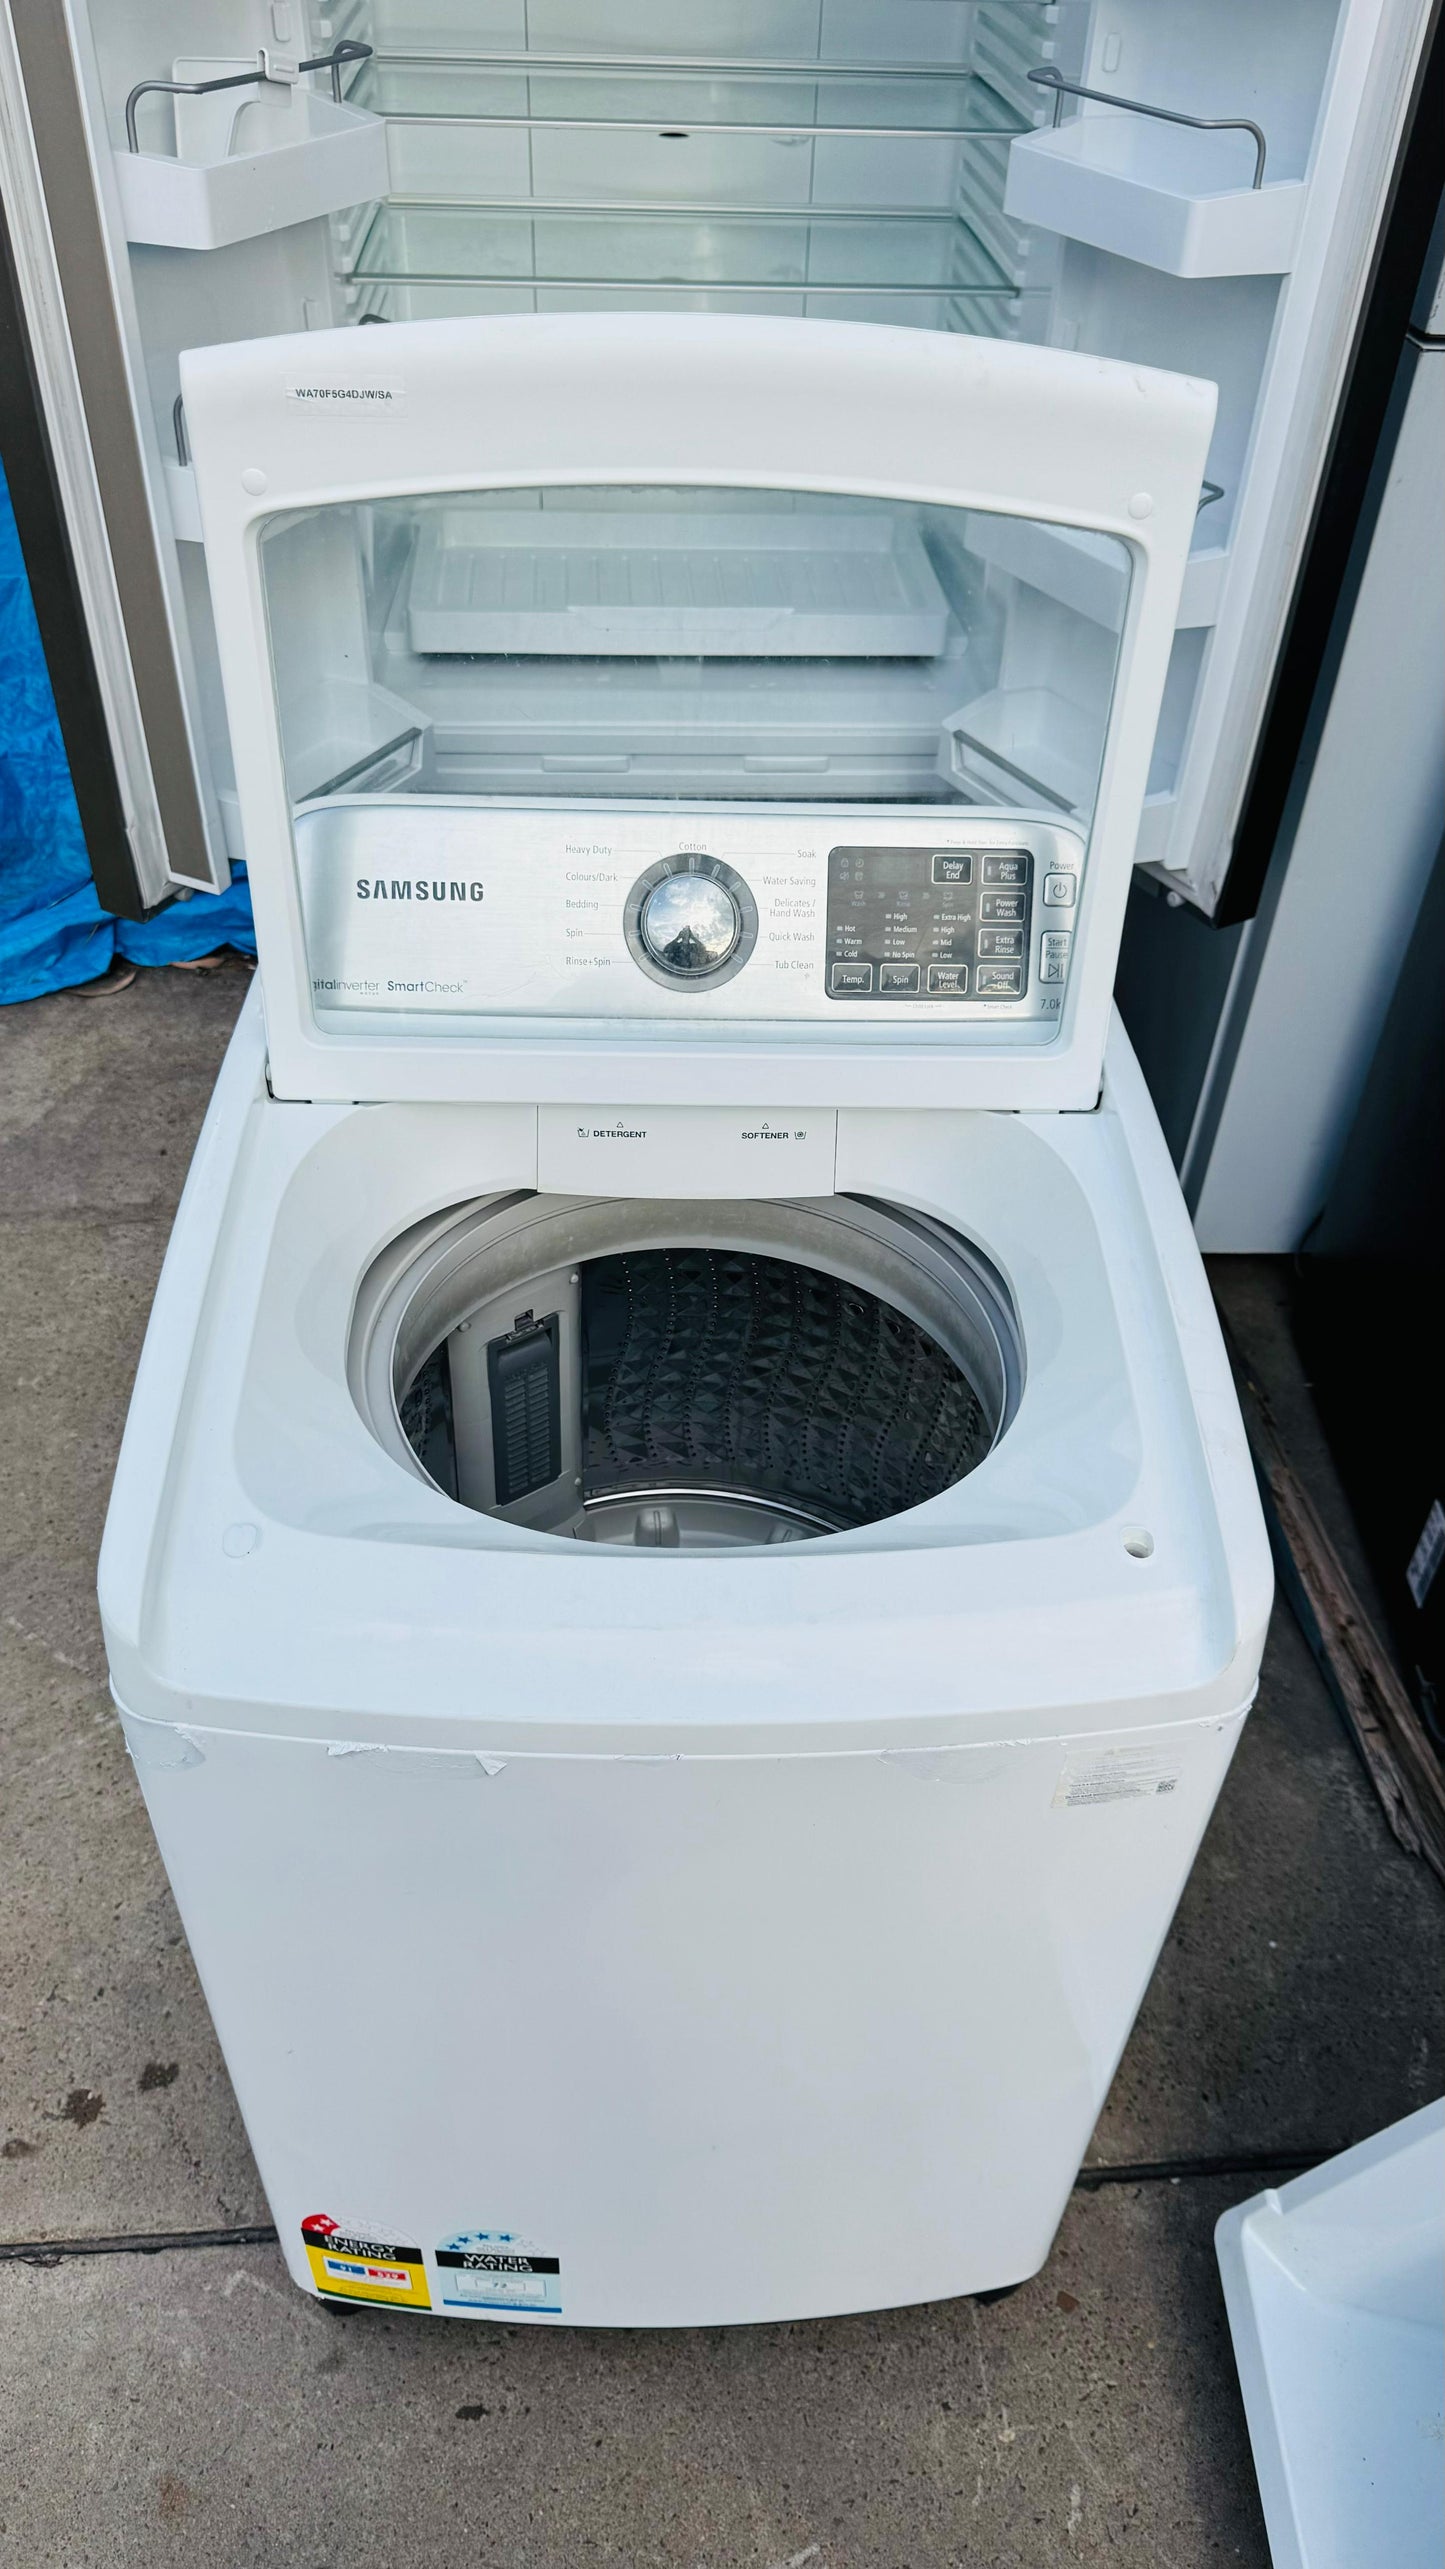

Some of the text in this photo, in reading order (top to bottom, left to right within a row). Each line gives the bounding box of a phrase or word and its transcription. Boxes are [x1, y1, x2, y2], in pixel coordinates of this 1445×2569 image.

[295, 388, 393, 399] WA70F5G4DJW/SA
[565, 844, 612, 856] Heavy Duty
[678, 842, 707, 852] Cotton
[797, 849, 817, 859] Soak
[943, 861, 964, 874] Delay
[998, 862, 1019, 873] Aqua
[1050, 861, 1074, 871] Power
[565, 872, 619, 882] Colours/Dark
[946, 871, 961, 880] End
[1000, 871, 1017, 881] Plus
[763, 876, 817, 888] Water Saving
[356, 879, 485, 902] SAMSUNG
[565, 899, 599, 912] Bedding
[774, 899, 811, 908] Delicates
[995, 899, 1018, 908] Power
[769, 908, 816, 918] Hand Wash
[893, 913, 908, 921] High
[941, 913, 971, 922] Extra High
[996, 908, 1017, 918] Wash
[565, 928, 583, 938] Spin
[844, 925, 856, 933] Hot
[893, 926, 918, 934] Medium
[941, 926, 955, 935] High
[769, 932, 816, 941] Quick Wash
[995, 935, 1015, 945] Extra
[1048, 936, 1067, 947] Start
[844, 938, 863, 946] Warm
[940, 939, 953, 947] Mid
[994, 944, 1015, 954] Rinse
[843, 951, 858, 959] Cold
[903, 951, 916, 960] Spin
[565, 957, 612, 968] Rinse+Spin
[775, 960, 815, 969] Tub Clean
[842, 974, 865, 986] Temp.
[892, 975, 910, 986] Spin
[937, 971, 960, 981] Water
[991, 971, 1015, 981] Sound
[593, 1130, 647, 1138] DETERGENT
[741, 1132, 789, 1140] SOFTENER
[324, 2234, 396, 2254] ENERGY
[328, 2242, 396, 2260] RATING
[464, 2253, 530, 2266] WATER
[463, 2261, 533, 2273] RATING
